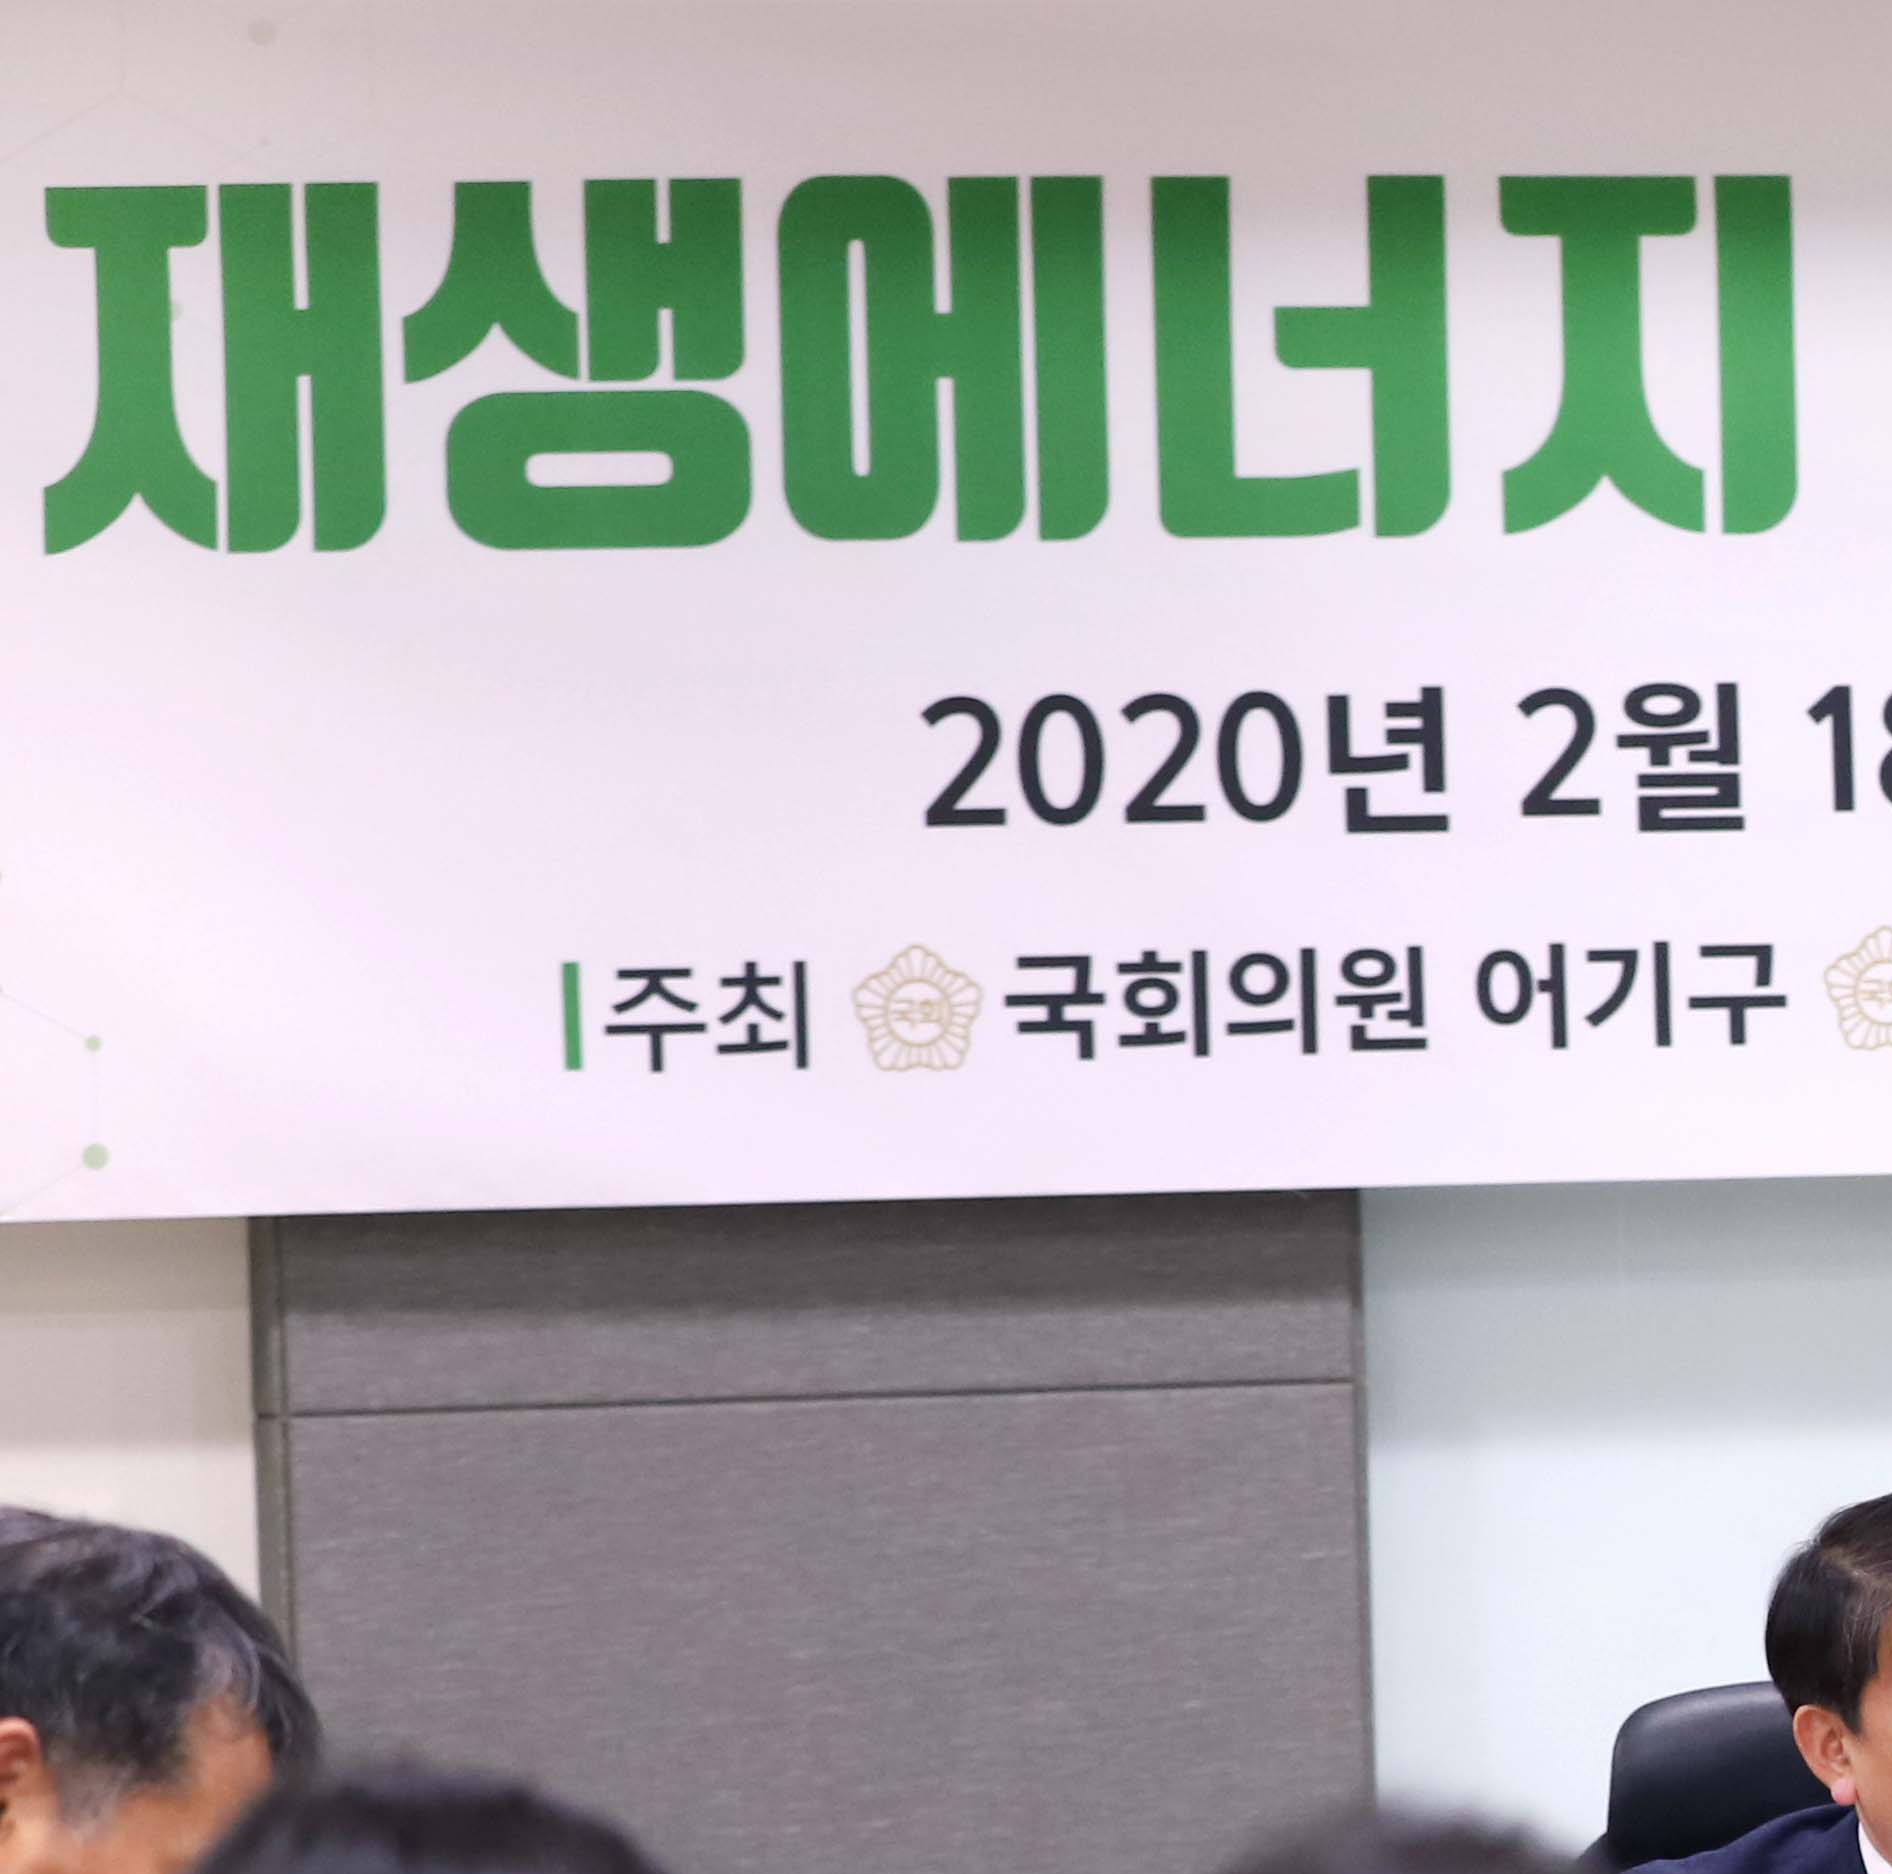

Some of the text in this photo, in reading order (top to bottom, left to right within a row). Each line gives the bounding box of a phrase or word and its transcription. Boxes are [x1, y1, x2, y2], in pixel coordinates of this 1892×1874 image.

[43, 174, 1800, 555] 재생에너지
[920, 686, 1450, 834] 2020년
[1517, 682, 1746, 833] 2월
[604, 960, 810, 1073] 주최
[1004, 945, 1428, 1061] 국회의원
[1476, 941, 1787, 1050] 어기구
